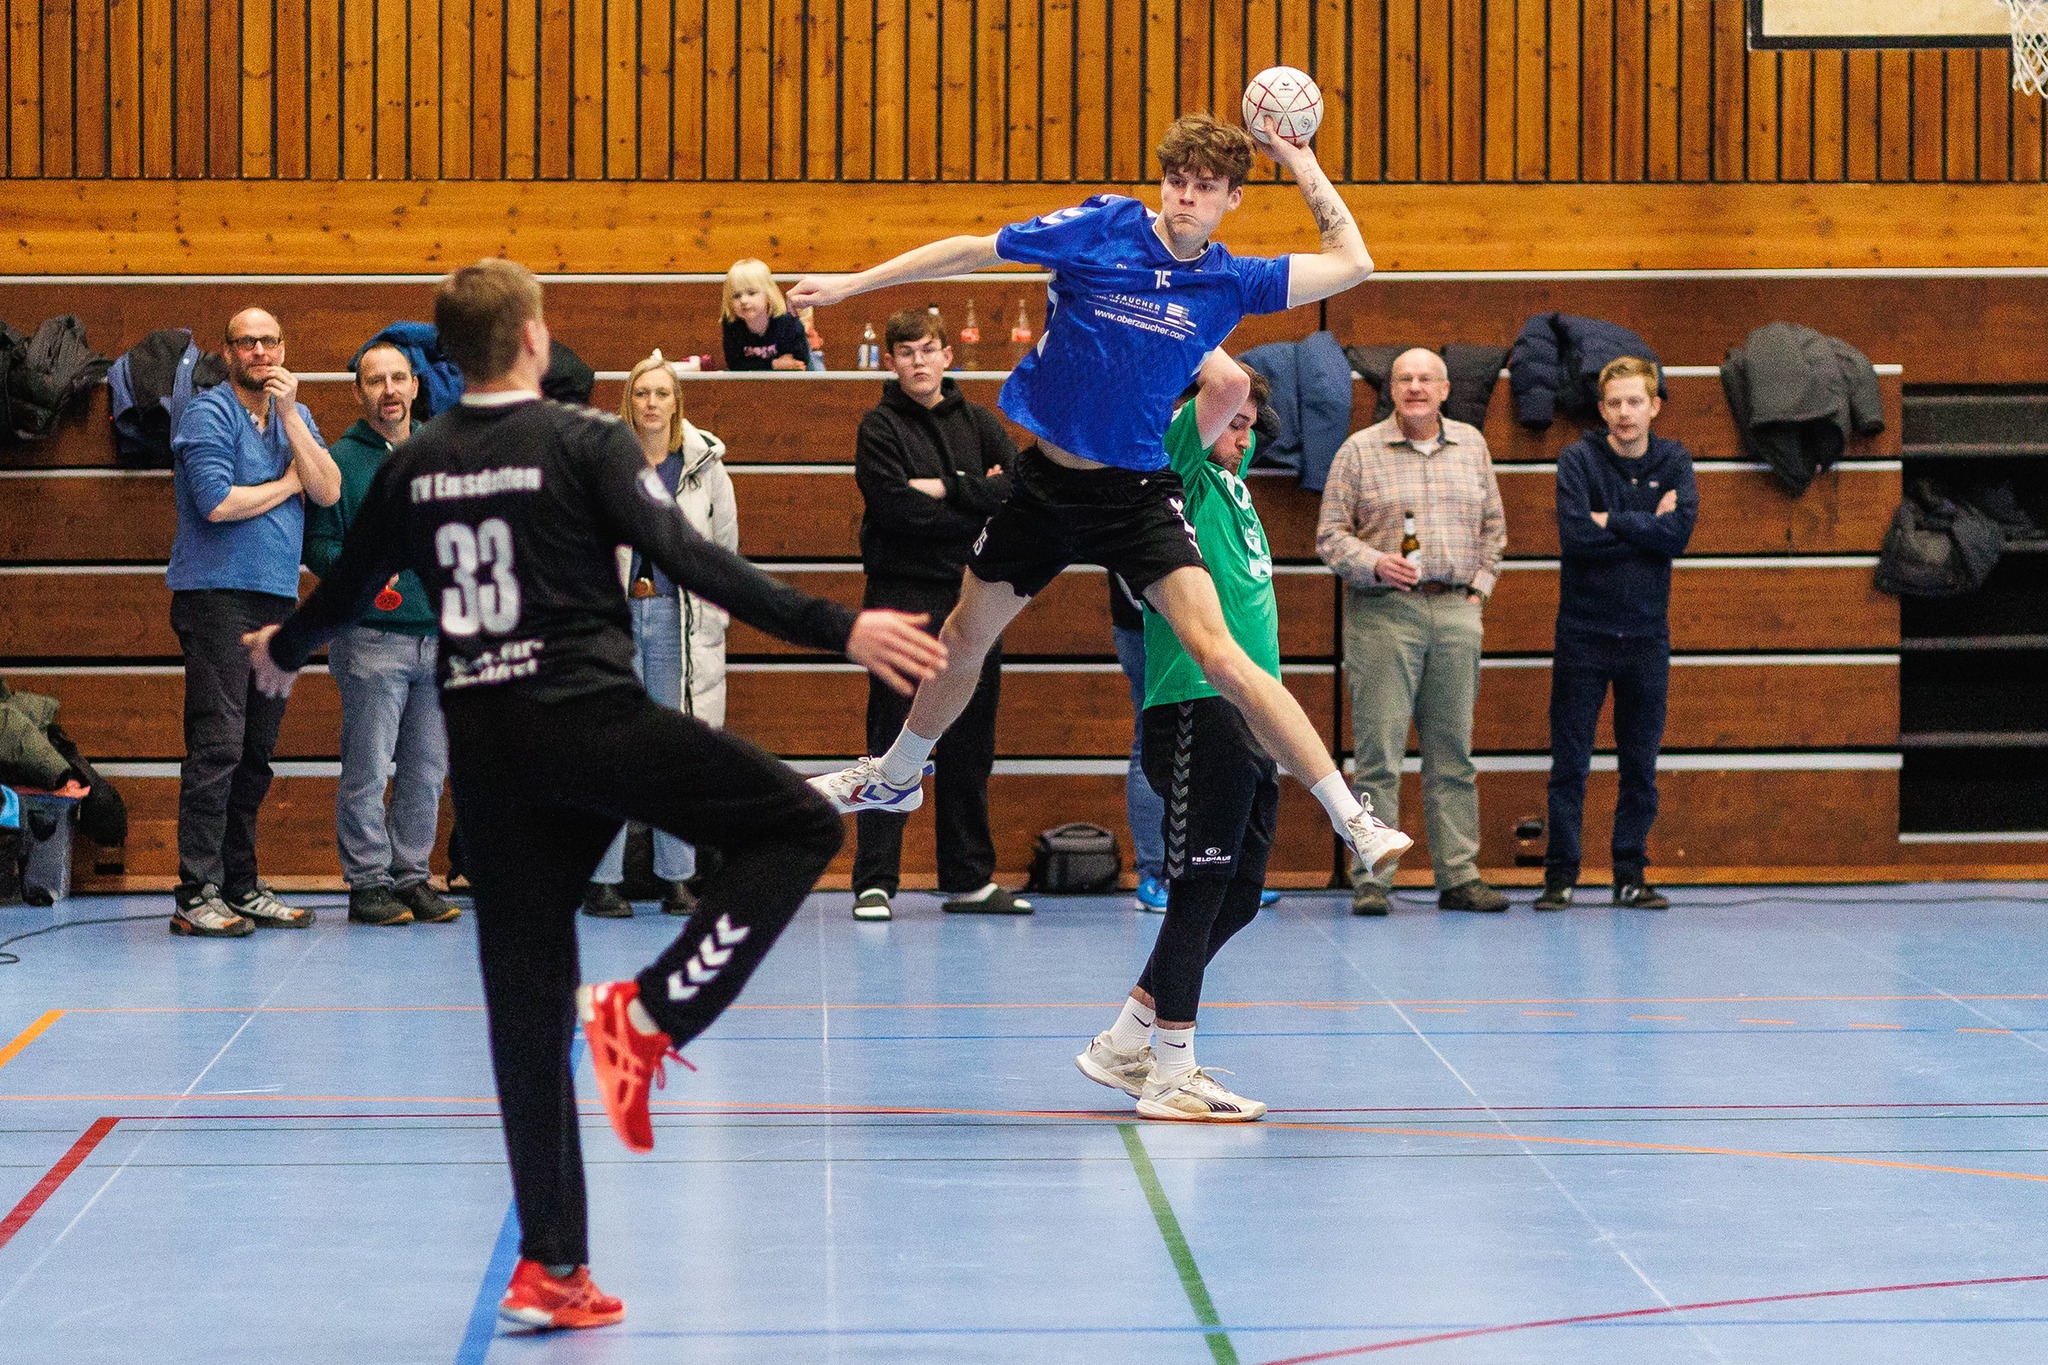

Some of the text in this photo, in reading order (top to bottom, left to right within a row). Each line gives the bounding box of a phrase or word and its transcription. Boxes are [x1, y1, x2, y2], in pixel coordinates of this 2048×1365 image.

[1154, 270, 1172, 289] 15
[1094, 309, 1186, 341] www.oberzaucher.com
[435, 518, 520, 636] 33
